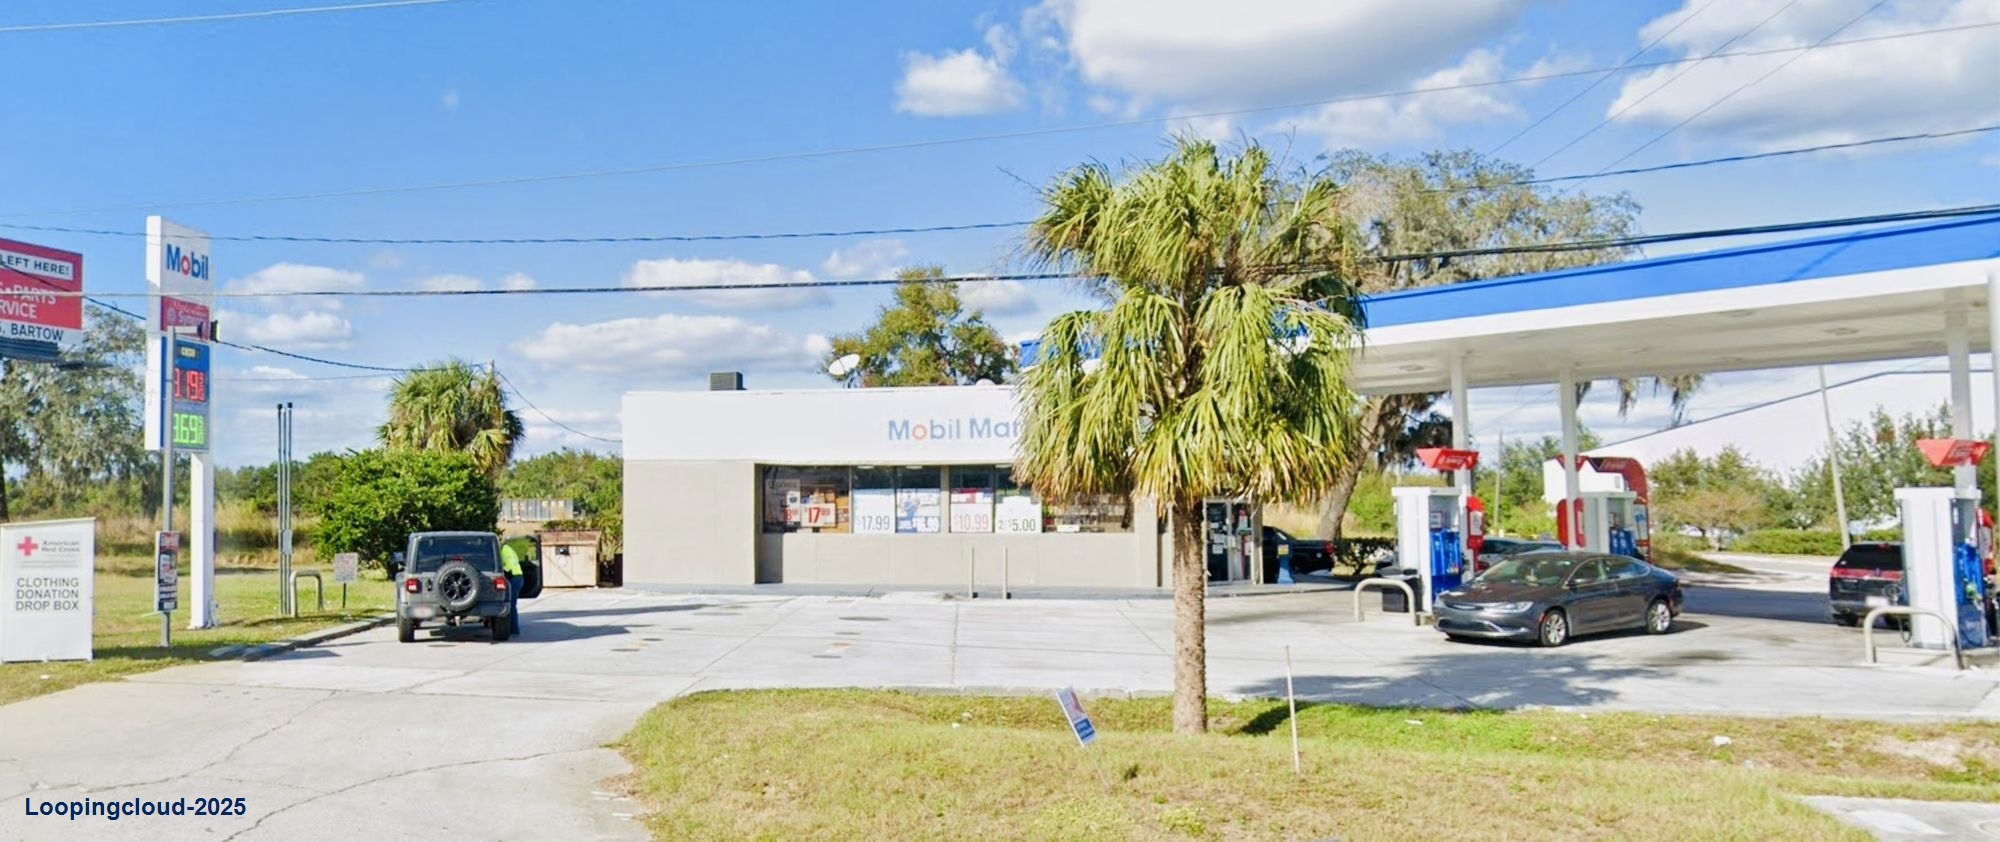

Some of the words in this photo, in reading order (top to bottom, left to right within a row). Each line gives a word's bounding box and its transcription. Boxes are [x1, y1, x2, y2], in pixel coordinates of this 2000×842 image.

[34, 261, 70, 276] HERE!
[167, 243, 209, 280] Mobil
[13, 284, 57, 305] PARTS
[11, 323, 64, 341] BARTOW
[888, 418, 961, 440] Mobil
[16, 577, 79, 588] CLOTHING
[16, 588, 79, 600] DONATION
[16, 600, 51, 611] DROP
[53, 600, 80, 611] BOX
